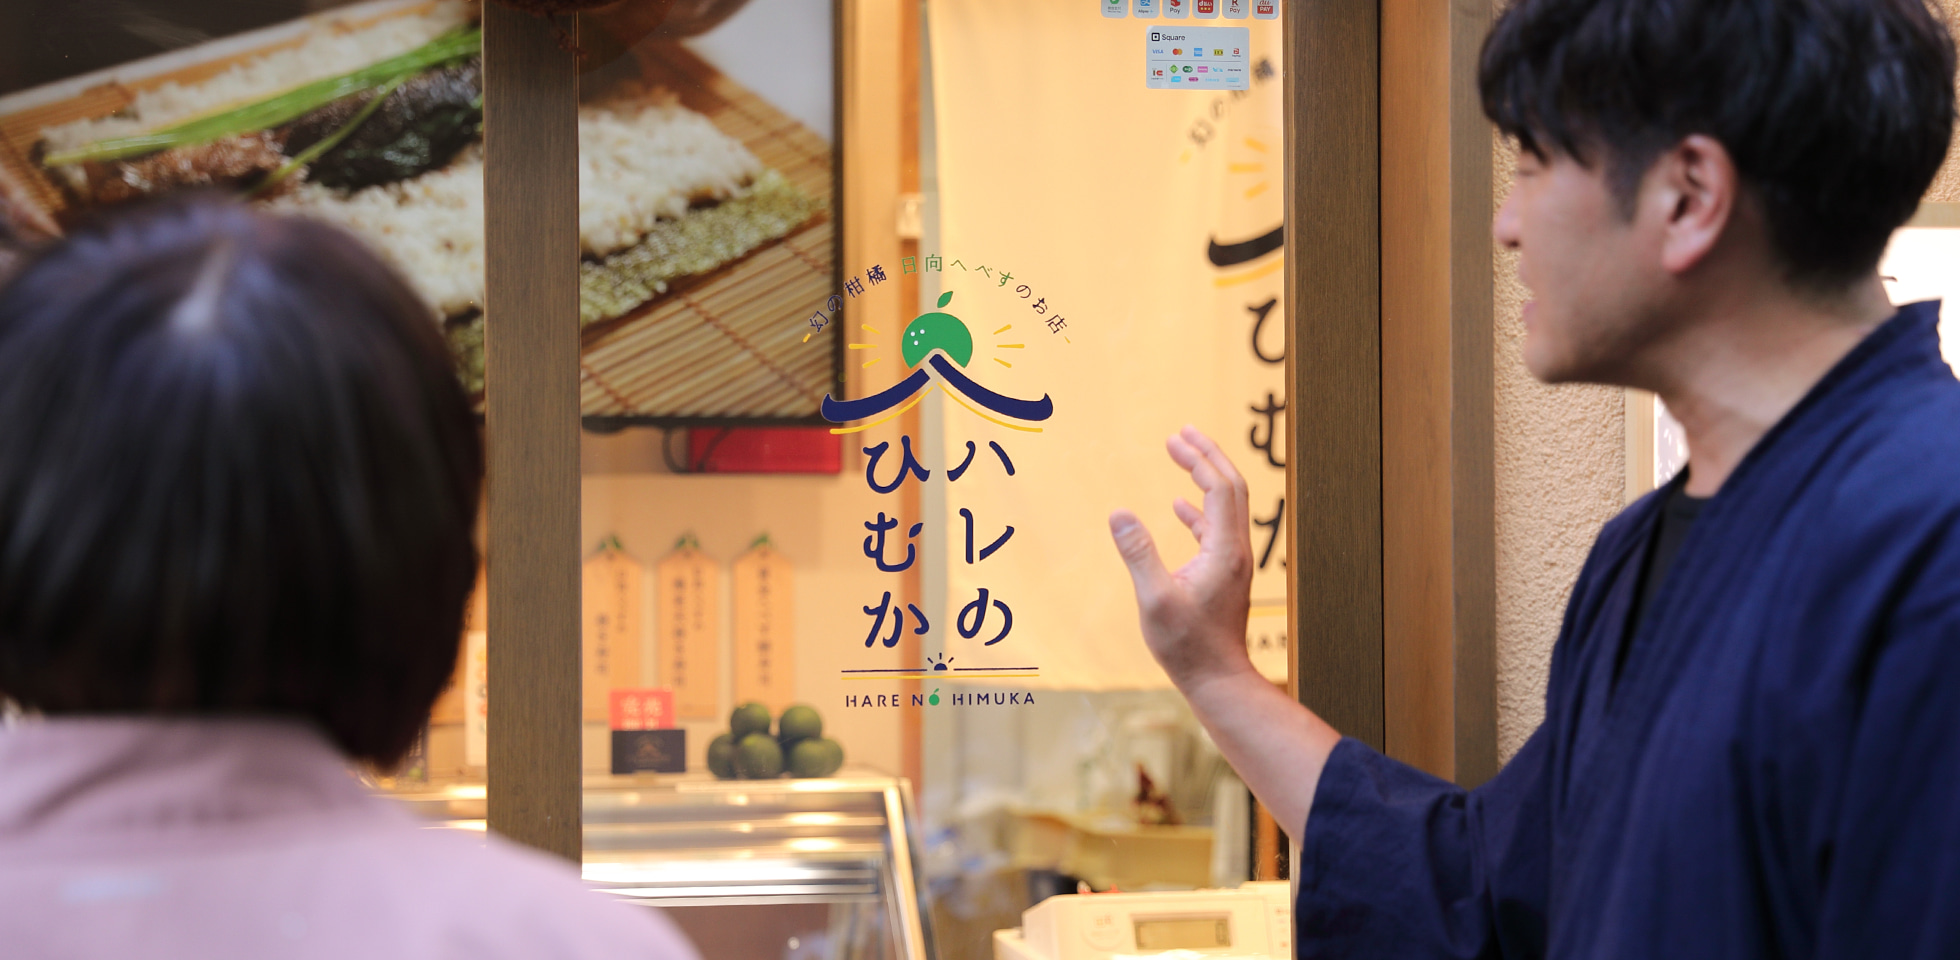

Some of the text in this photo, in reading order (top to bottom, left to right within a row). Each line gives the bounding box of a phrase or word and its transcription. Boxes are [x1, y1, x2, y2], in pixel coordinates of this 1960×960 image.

[1161, 33, 1186, 42] Square
[808, 264, 888, 334] 幻の柑橘
[862, 434, 931, 649] ひむか
[946, 440, 1016, 647] ハレの
[845, 693, 901, 708] HARE
[952, 691, 1036, 707] HIMUKA
